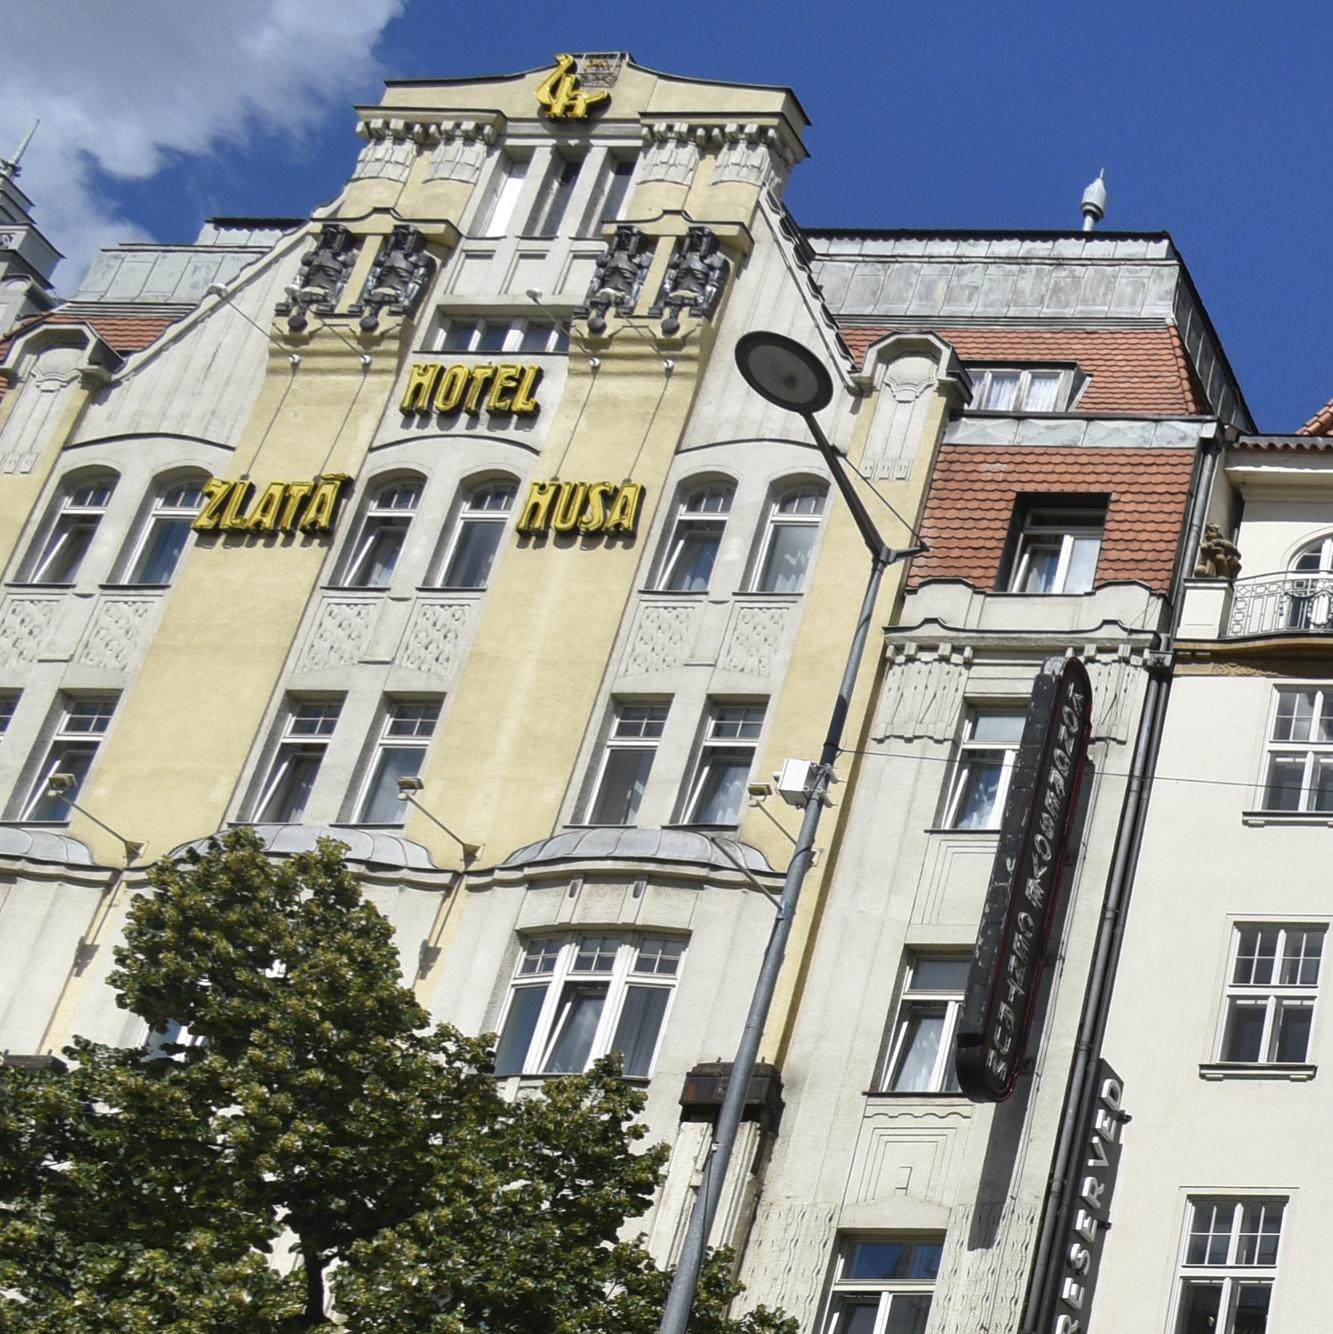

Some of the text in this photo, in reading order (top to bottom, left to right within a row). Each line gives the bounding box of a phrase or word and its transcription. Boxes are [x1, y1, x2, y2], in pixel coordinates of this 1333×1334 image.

[398, 361, 542, 418] HOTEL
[191, 474, 646, 539] ZLATÁ HUSA
